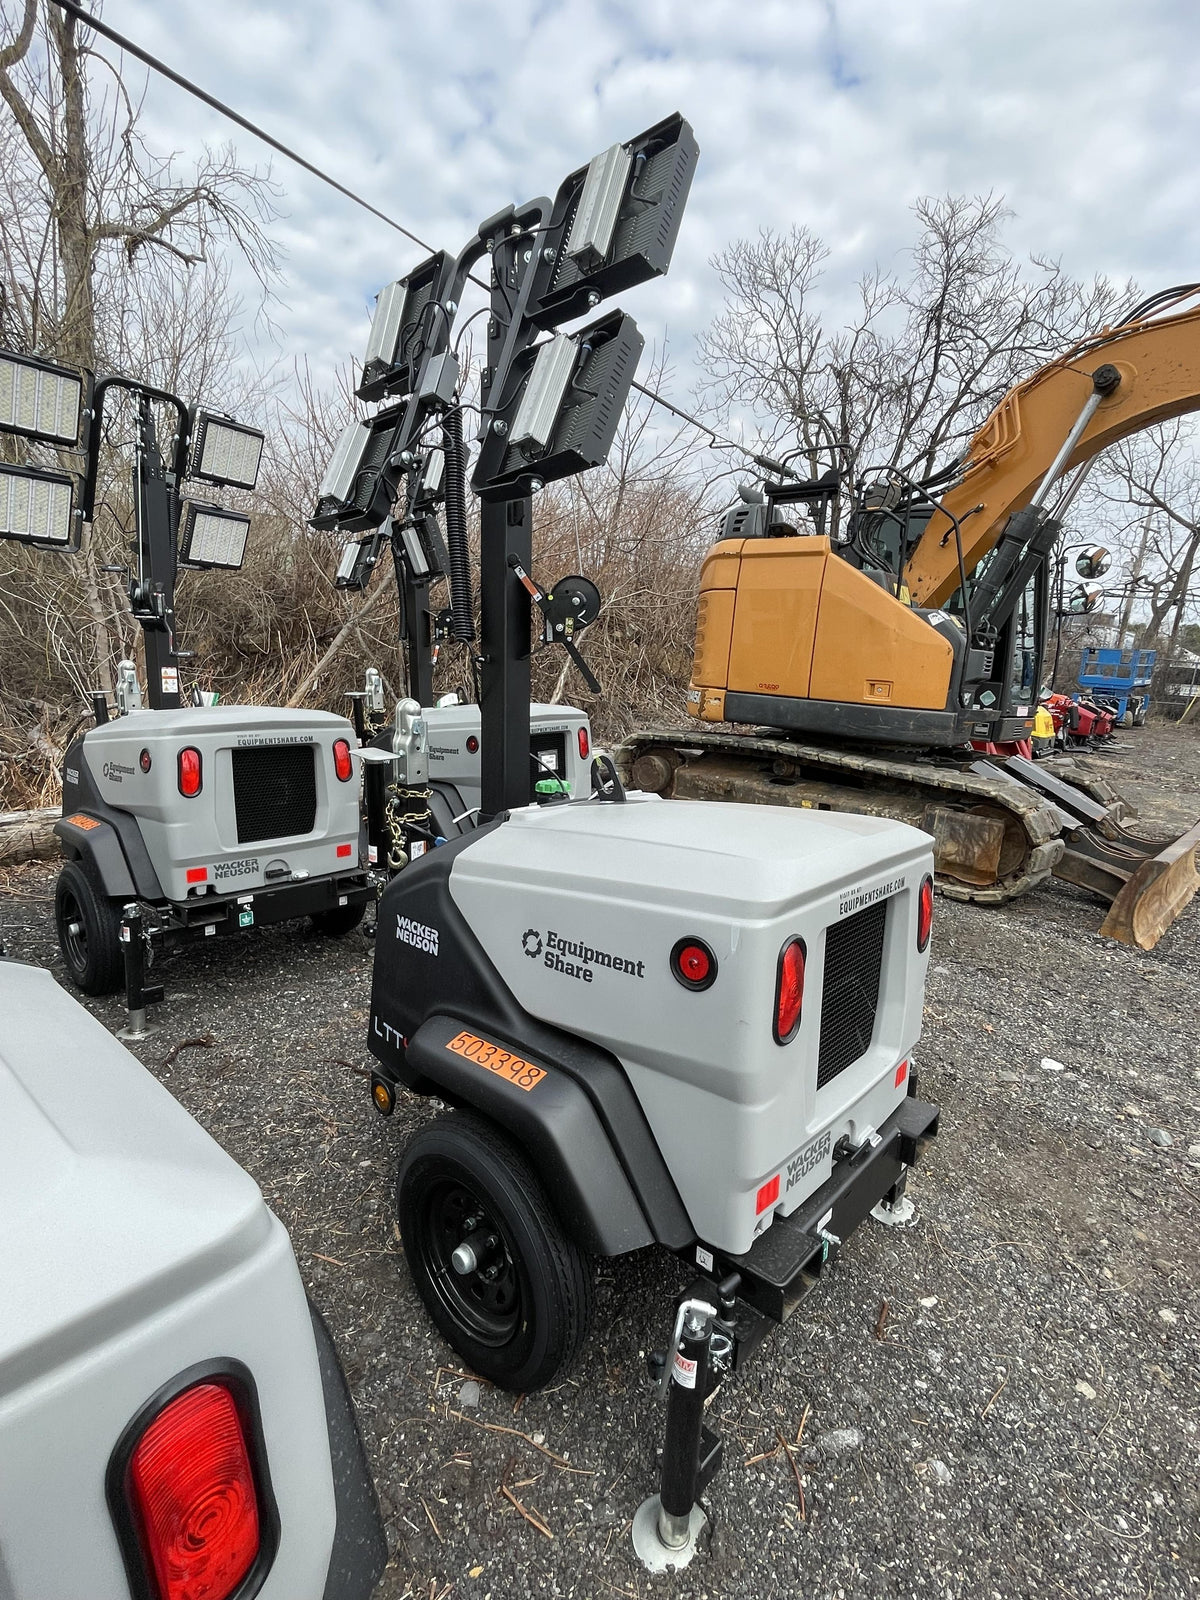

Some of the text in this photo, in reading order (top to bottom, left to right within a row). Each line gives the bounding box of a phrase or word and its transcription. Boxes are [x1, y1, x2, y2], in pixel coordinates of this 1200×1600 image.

[238, 736, 314, 746] EQUIPMENTSHARE.COM
[213, 858, 259, 872] WACKER
[215, 866, 260, 880] NEUSON
[839, 876, 906, 915] EQUIPMENTSHARE.COM
[396, 914, 440, 943] WACKER
[396, 926, 439, 957] NEUSON
[544, 951, 593, 983] Share
[546, 930, 645, 979] Equipment
[451, 1033, 541, 1087] 503398
[785, 1143, 831, 1193] NEUSON
[786, 1130, 831, 1177] WACKER
